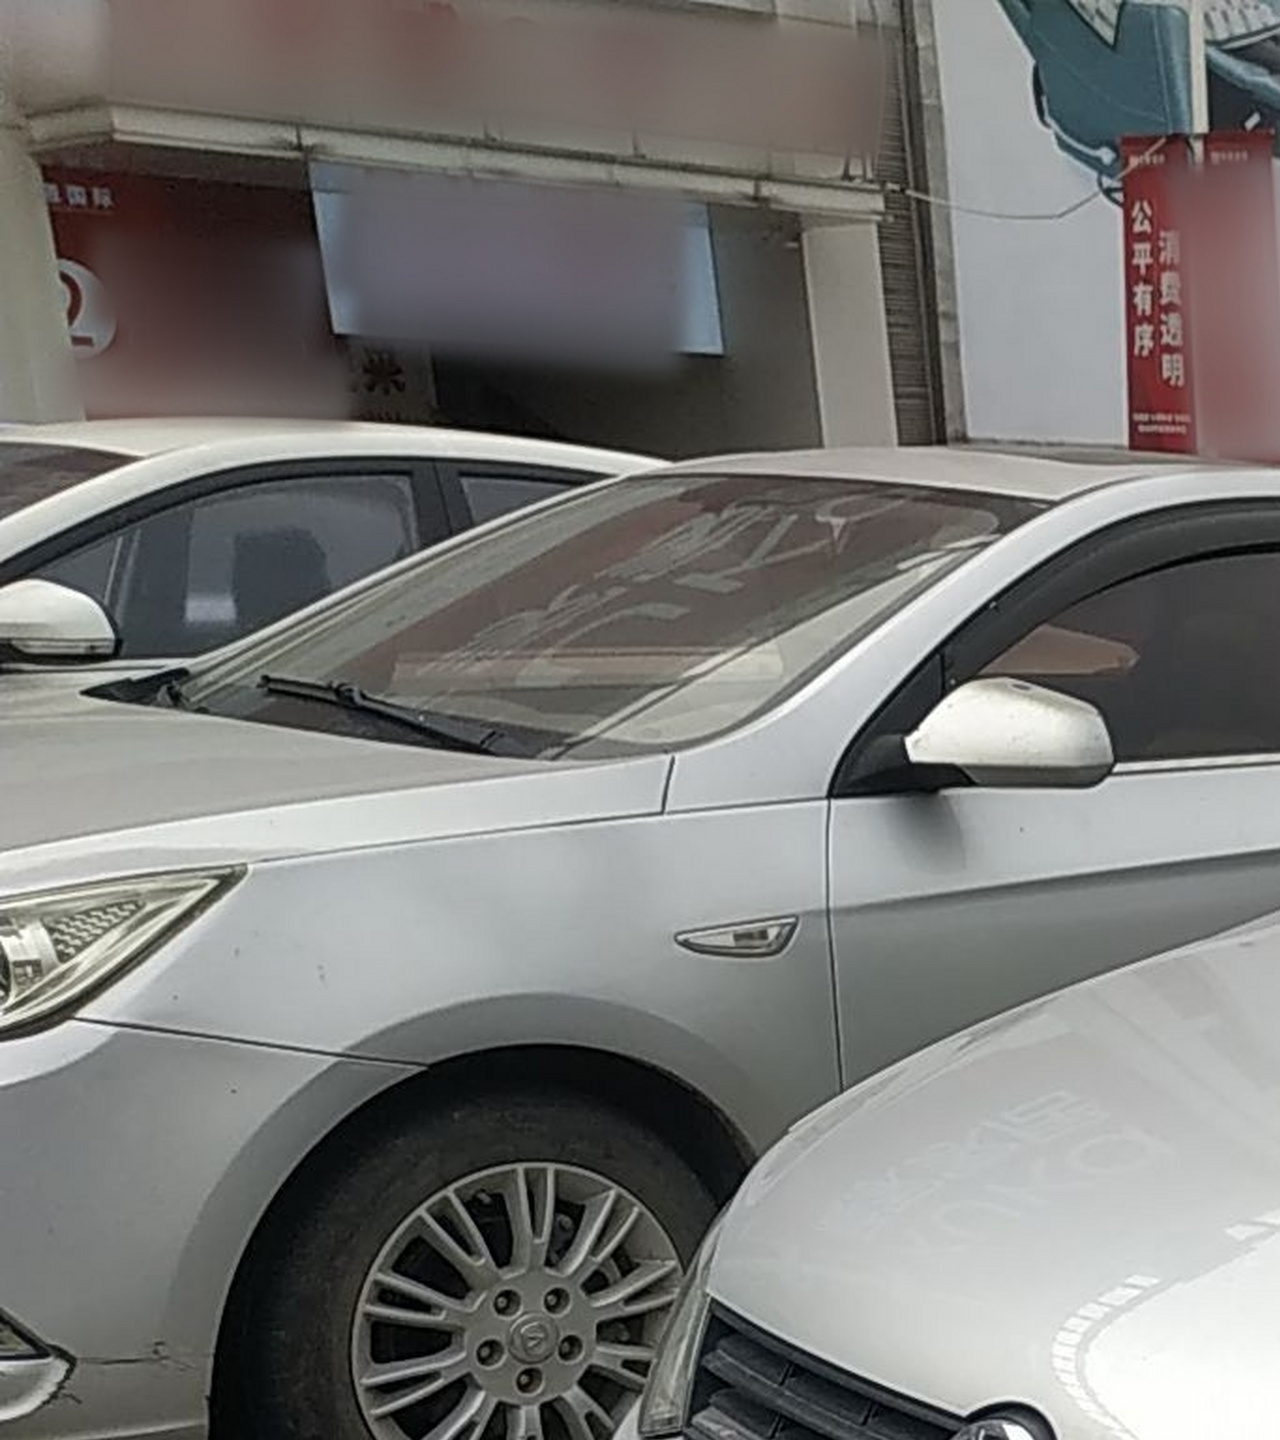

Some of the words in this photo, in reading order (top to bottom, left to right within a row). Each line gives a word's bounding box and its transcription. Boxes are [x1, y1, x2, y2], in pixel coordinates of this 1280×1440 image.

[1132, 200, 1154, 358] 公平有序
[1159, 229, 1184, 387] 消费透明
